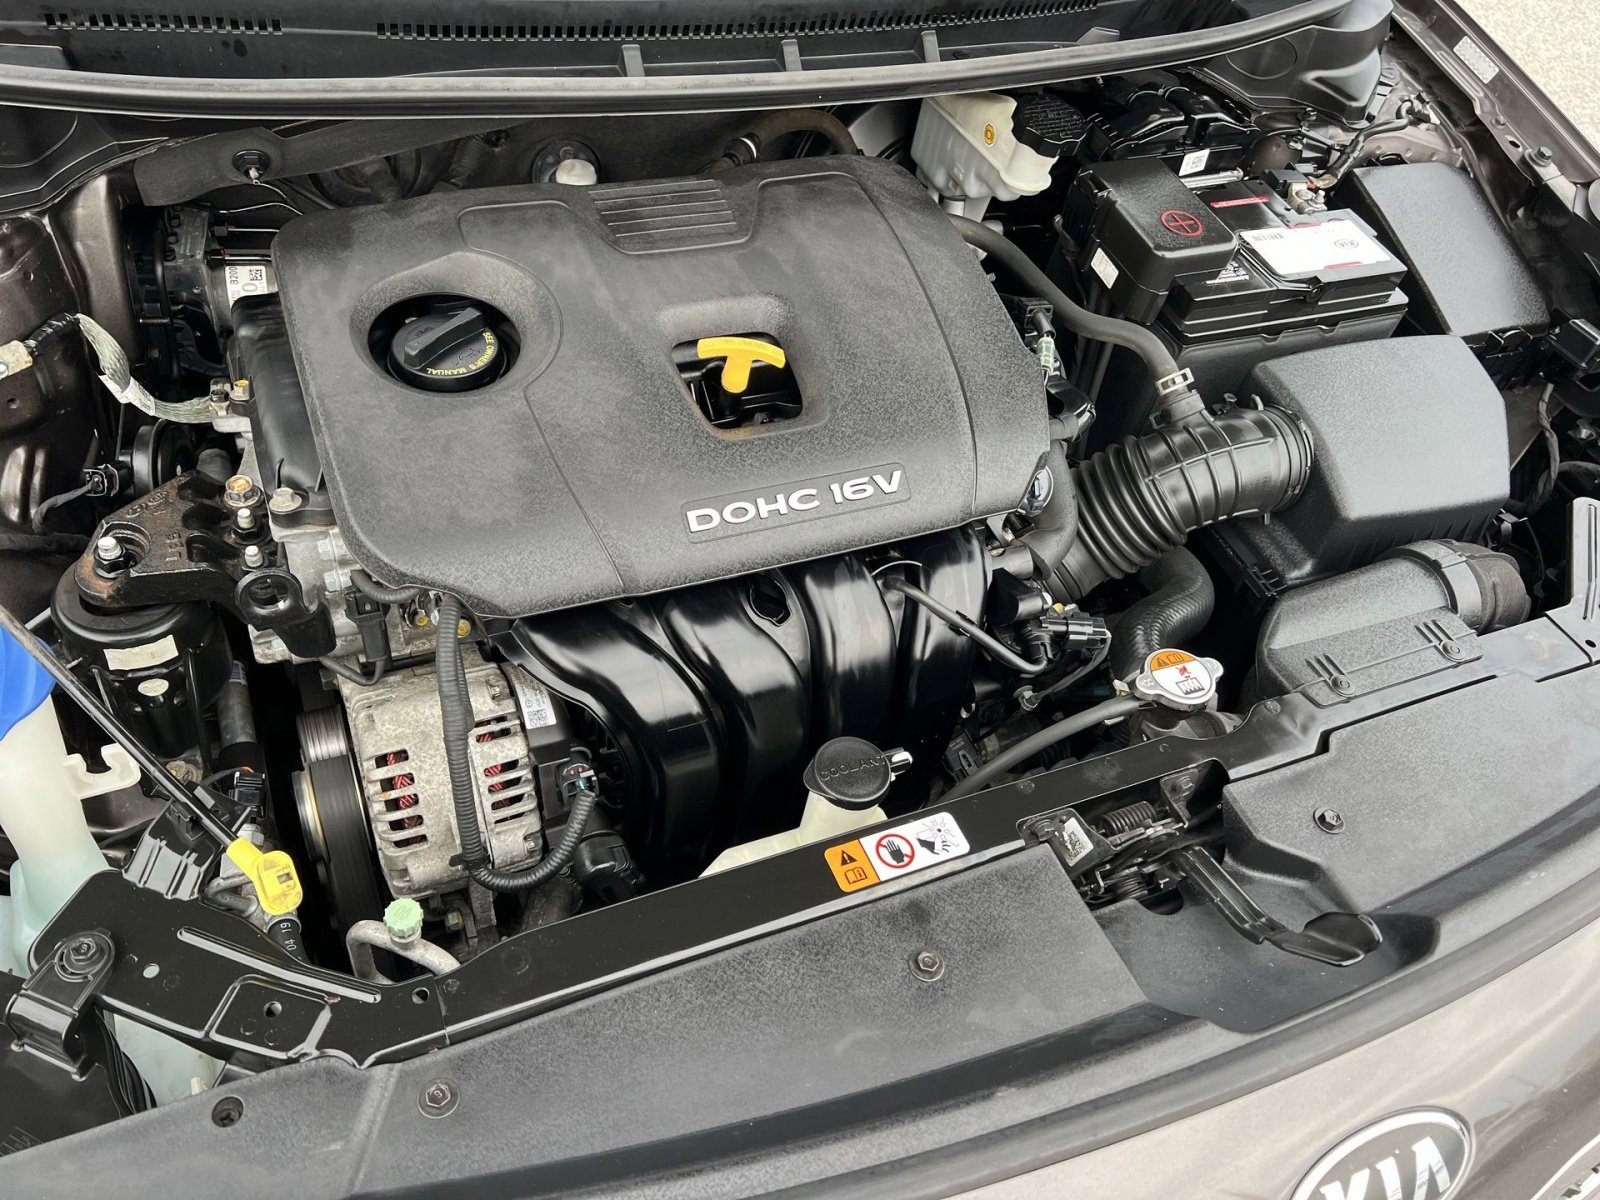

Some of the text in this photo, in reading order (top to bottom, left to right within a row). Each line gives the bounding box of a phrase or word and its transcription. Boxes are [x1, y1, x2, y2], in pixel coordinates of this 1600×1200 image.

[426, 332, 495, 376] SEE OWNER'S MANUAL
[686, 470, 902, 533] DOHC 16V
[820, 755, 886, 781] COOLANT
